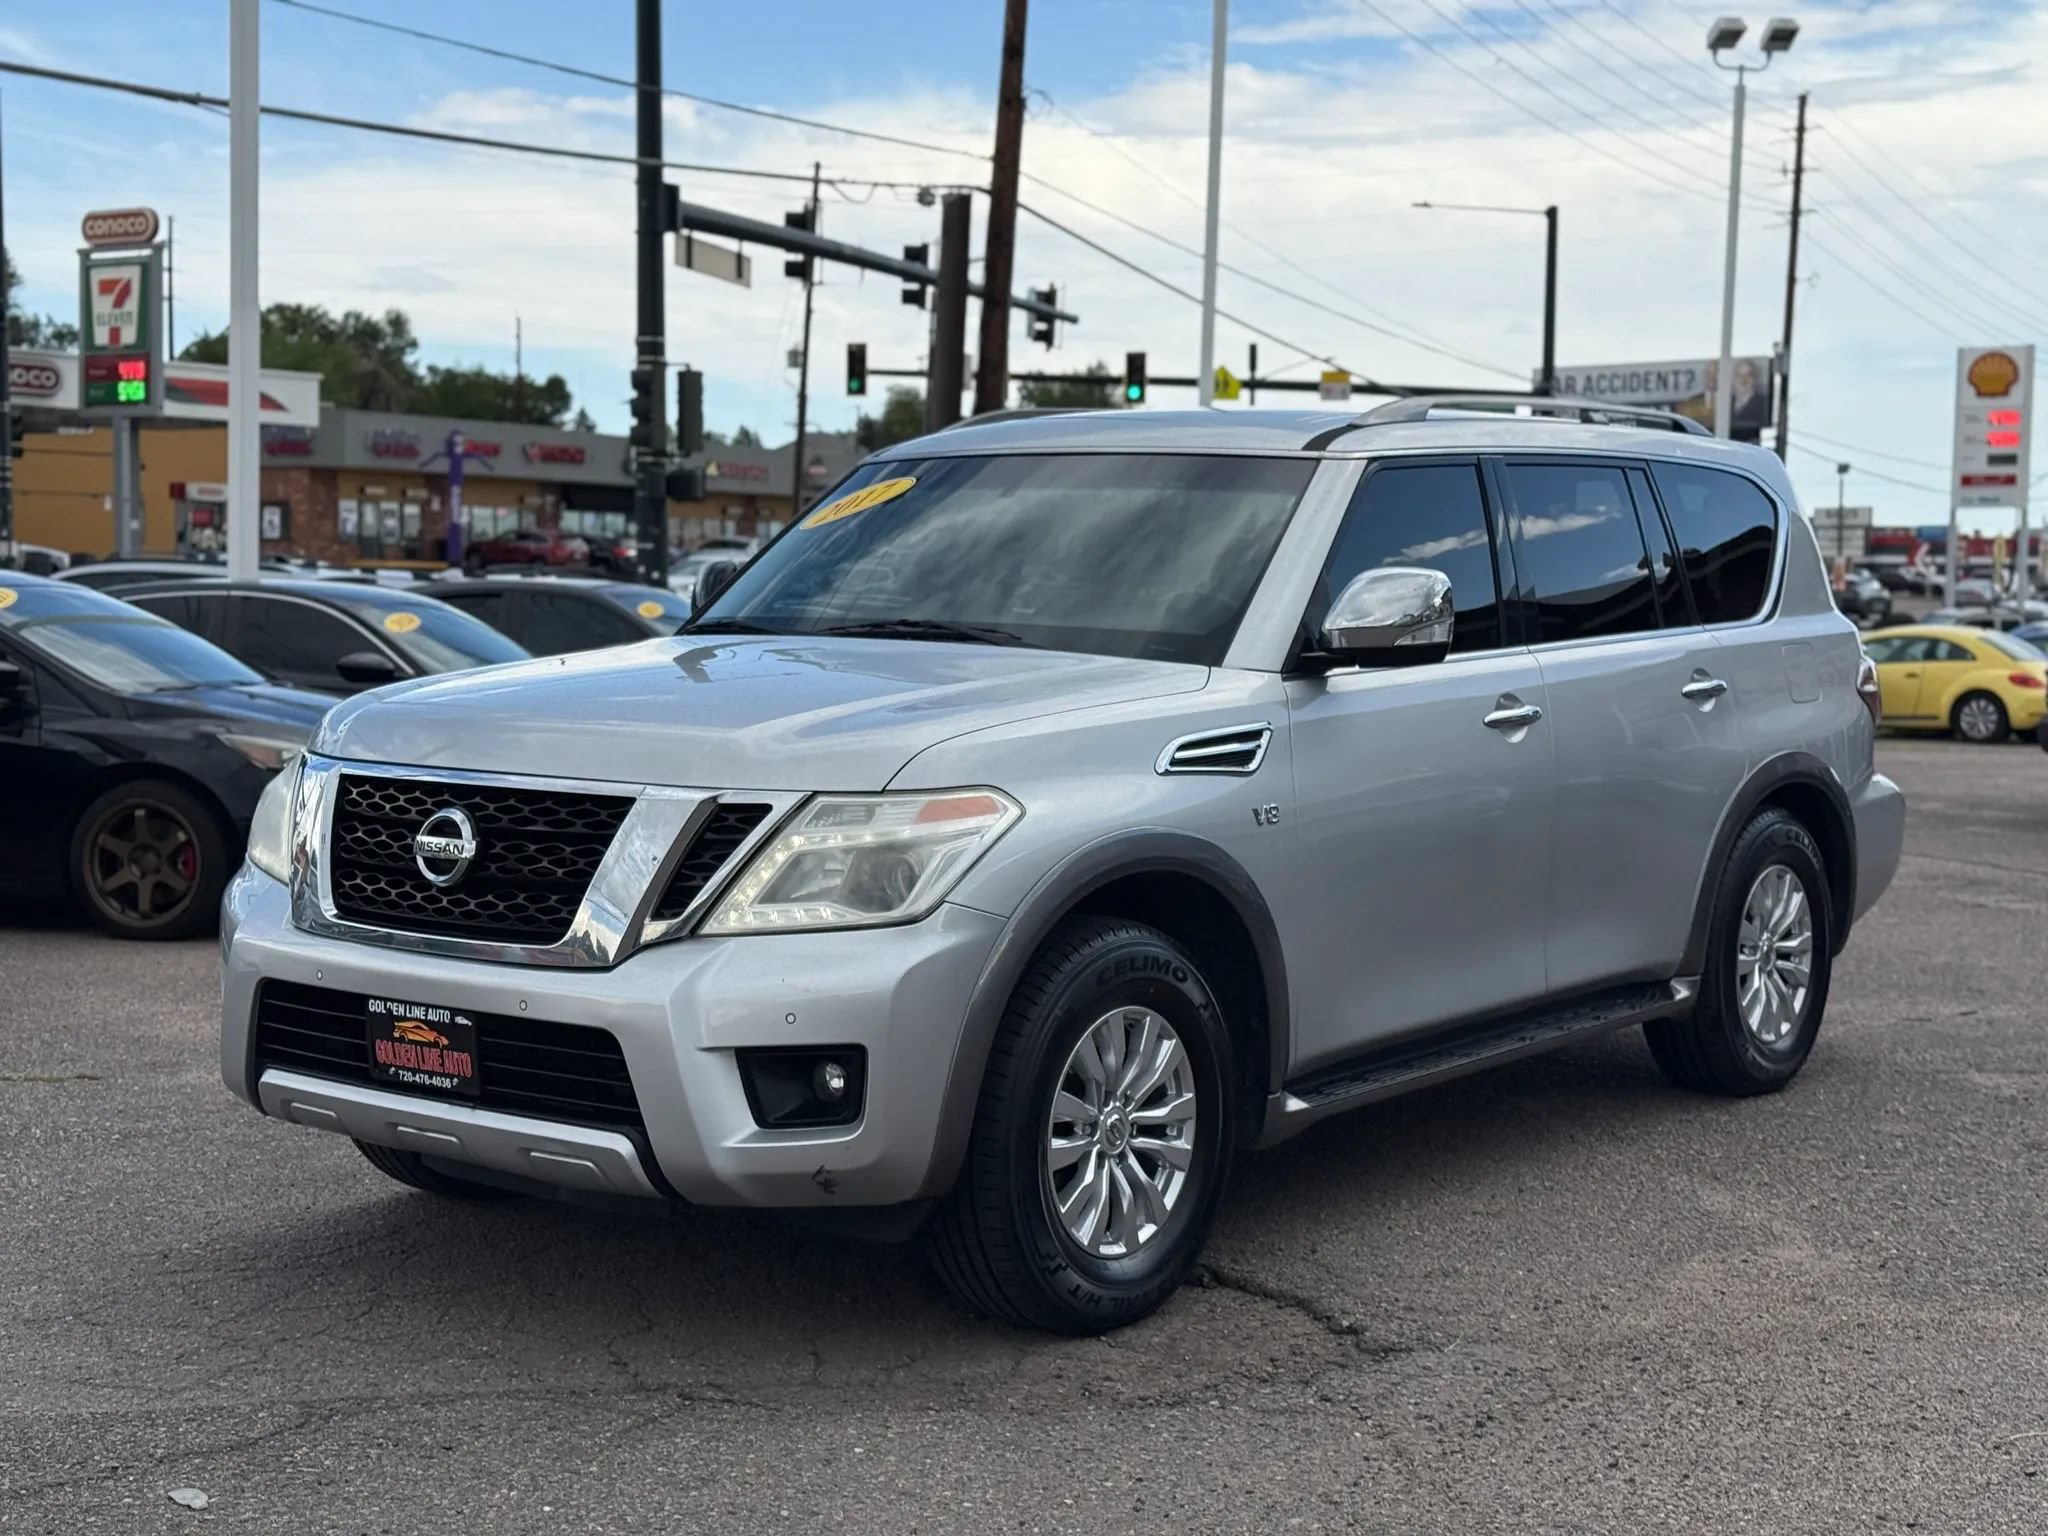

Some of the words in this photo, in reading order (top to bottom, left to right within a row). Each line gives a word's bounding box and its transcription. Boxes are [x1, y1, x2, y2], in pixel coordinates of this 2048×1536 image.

[86, 215, 145, 237] conoco
[98, 277, 132, 309] 7
[1582, 369, 1697, 397] ACCIDENT?
[1251, 804, 1280, 826] V8
[415, 839, 465, 856] NISSAN
[1096, 954, 1189, 986] CELIMO
[406, 1004, 426, 1020] LINE
[427, 1007, 451, 1023] AUTO
[375, 1038, 419, 1069] GOLDEN
[417, 1045, 444, 1073] LINE
[443, 1049, 473, 1078] AUTO
